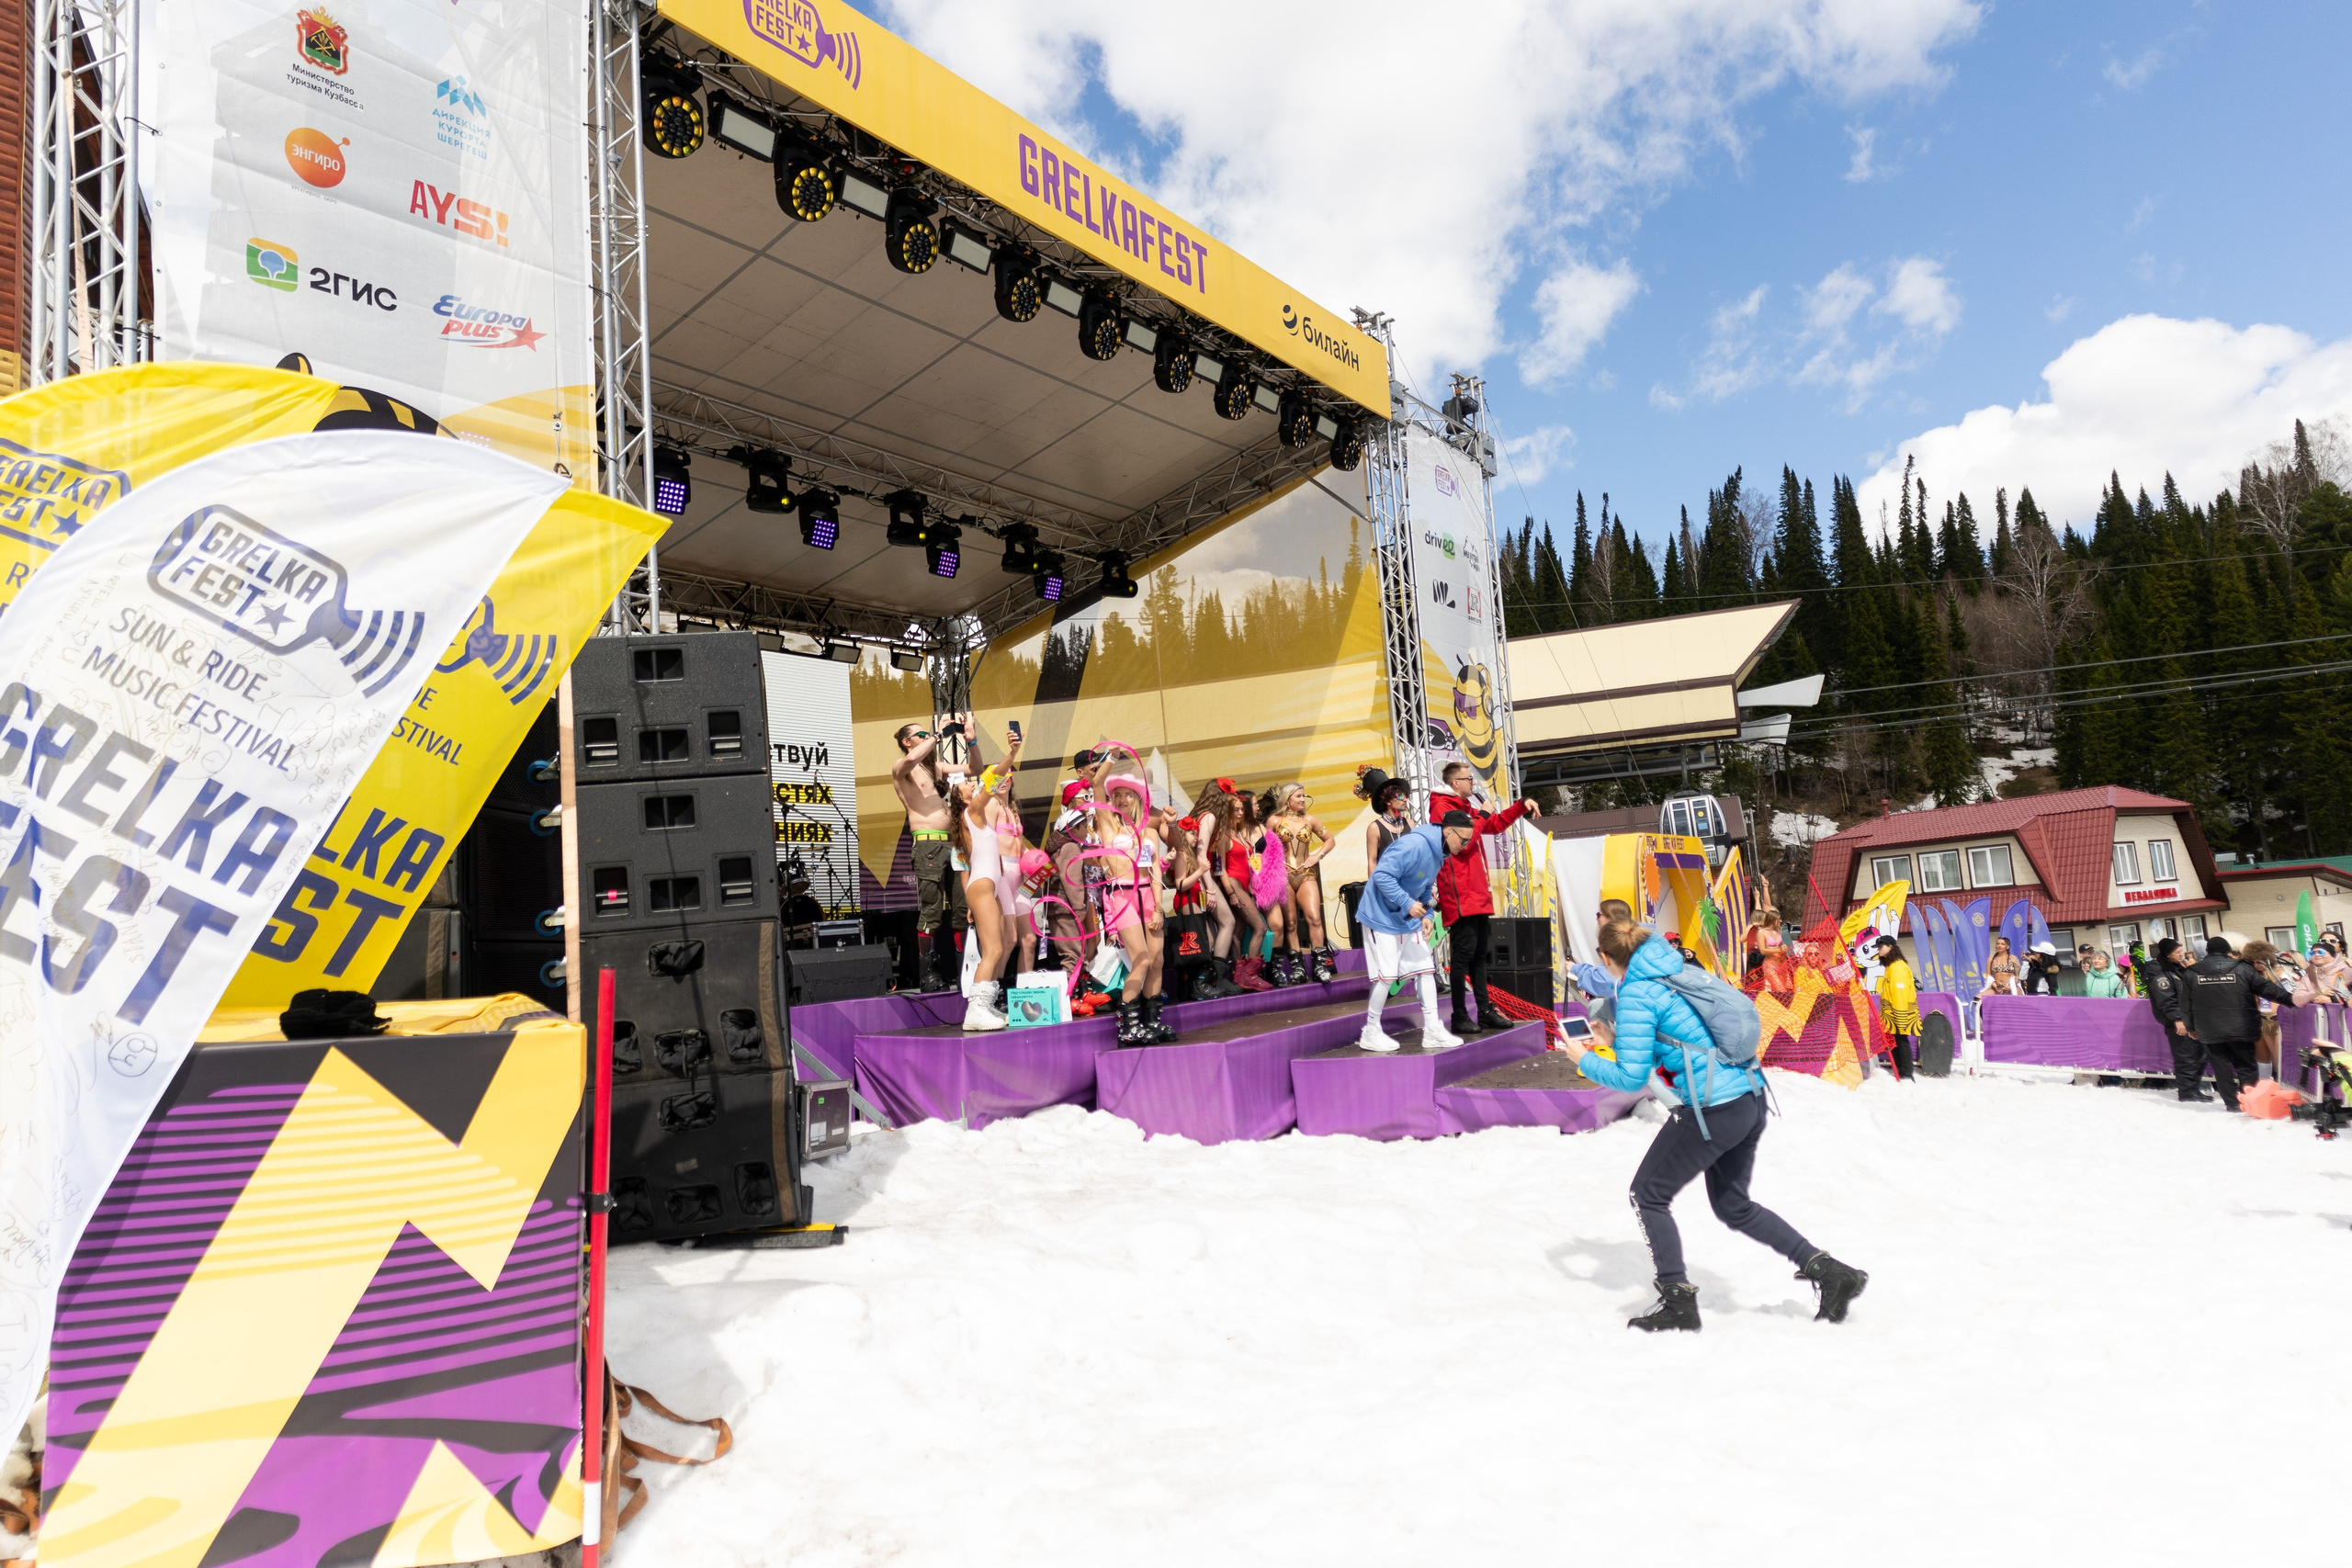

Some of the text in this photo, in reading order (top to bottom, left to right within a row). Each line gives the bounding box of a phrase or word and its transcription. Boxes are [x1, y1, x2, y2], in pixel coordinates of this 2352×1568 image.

[756, 5, 794, 45] FEST
[758, 0, 812, 32] ELKA
[287, 73, 364, 110] туризма Кузбасса
[292, 63, 355, 96] Министерство
[433, 108, 491, 139] ДИРЕКЦИЯ
[438, 120, 487, 149] КУРОРТА
[291, 143, 341, 172] энгиро
[437, 132, 487, 160] ШЕРЕГЕШ
[410, 179, 509, 248] AYS!
[1019, 133, 1208, 295] GRELKAFEST
[310, 266, 398, 312] 2ГИС
[433, 294, 526, 329] Europa
[1303, 316, 1360, 372] билайн
[0, 489, 56, 529] ST
[198, 521, 329, 605] GRELKA
[1425, 530, 1455, 557] drivee
[169, 555, 268, 617] FEST
[109, 606, 268, 703] SUN & RIDE
[81, 645, 296, 773] MUSIC FESTIVAL
[390, 716, 463, 766] STIVAL
[773, 783, 832, 804] стях
[311, 795, 446, 894] LKA
[0, 800, 240, 1027] EST
[251, 867, 406, 978] ST
